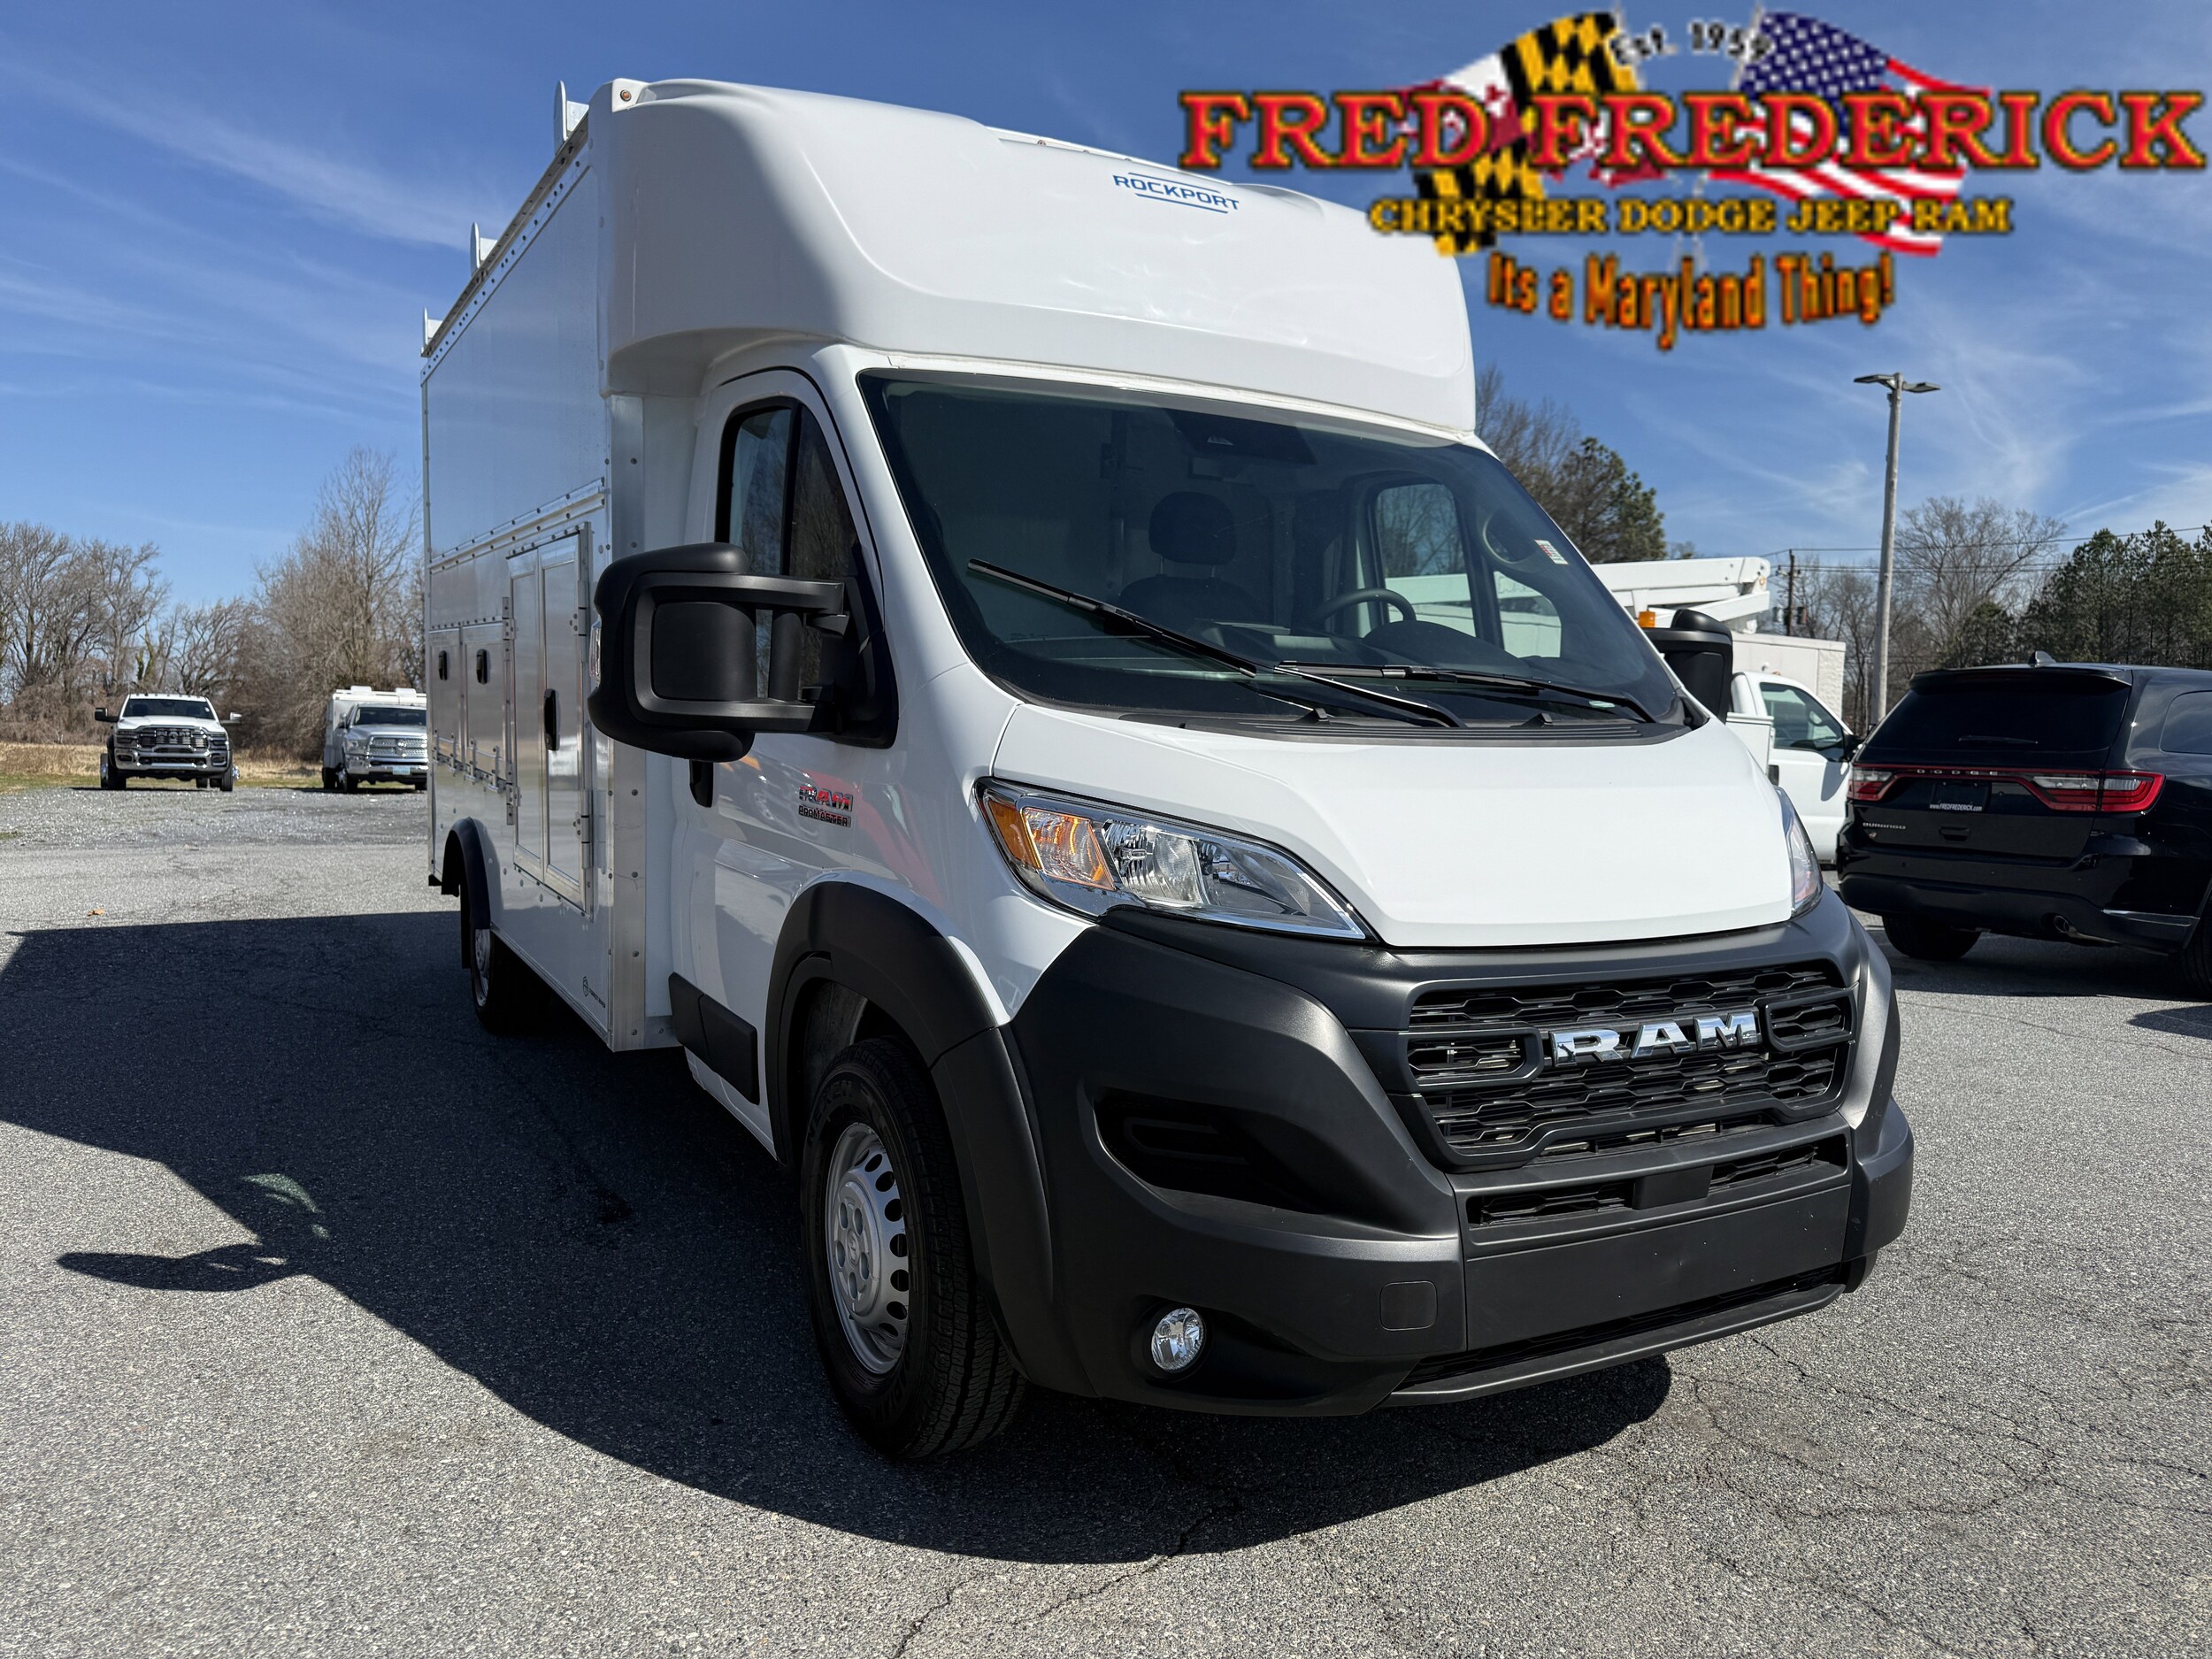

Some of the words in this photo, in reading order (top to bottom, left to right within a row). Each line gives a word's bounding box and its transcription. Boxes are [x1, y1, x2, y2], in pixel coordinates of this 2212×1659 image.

[1112, 174, 1240, 210] ROCKPORT
[1916, 768, 1999, 777] DODGE
[798, 785, 854, 812] RAM
[798, 804, 851, 827] PROMASTER
[1550, 1011, 1761, 1067] RAM
